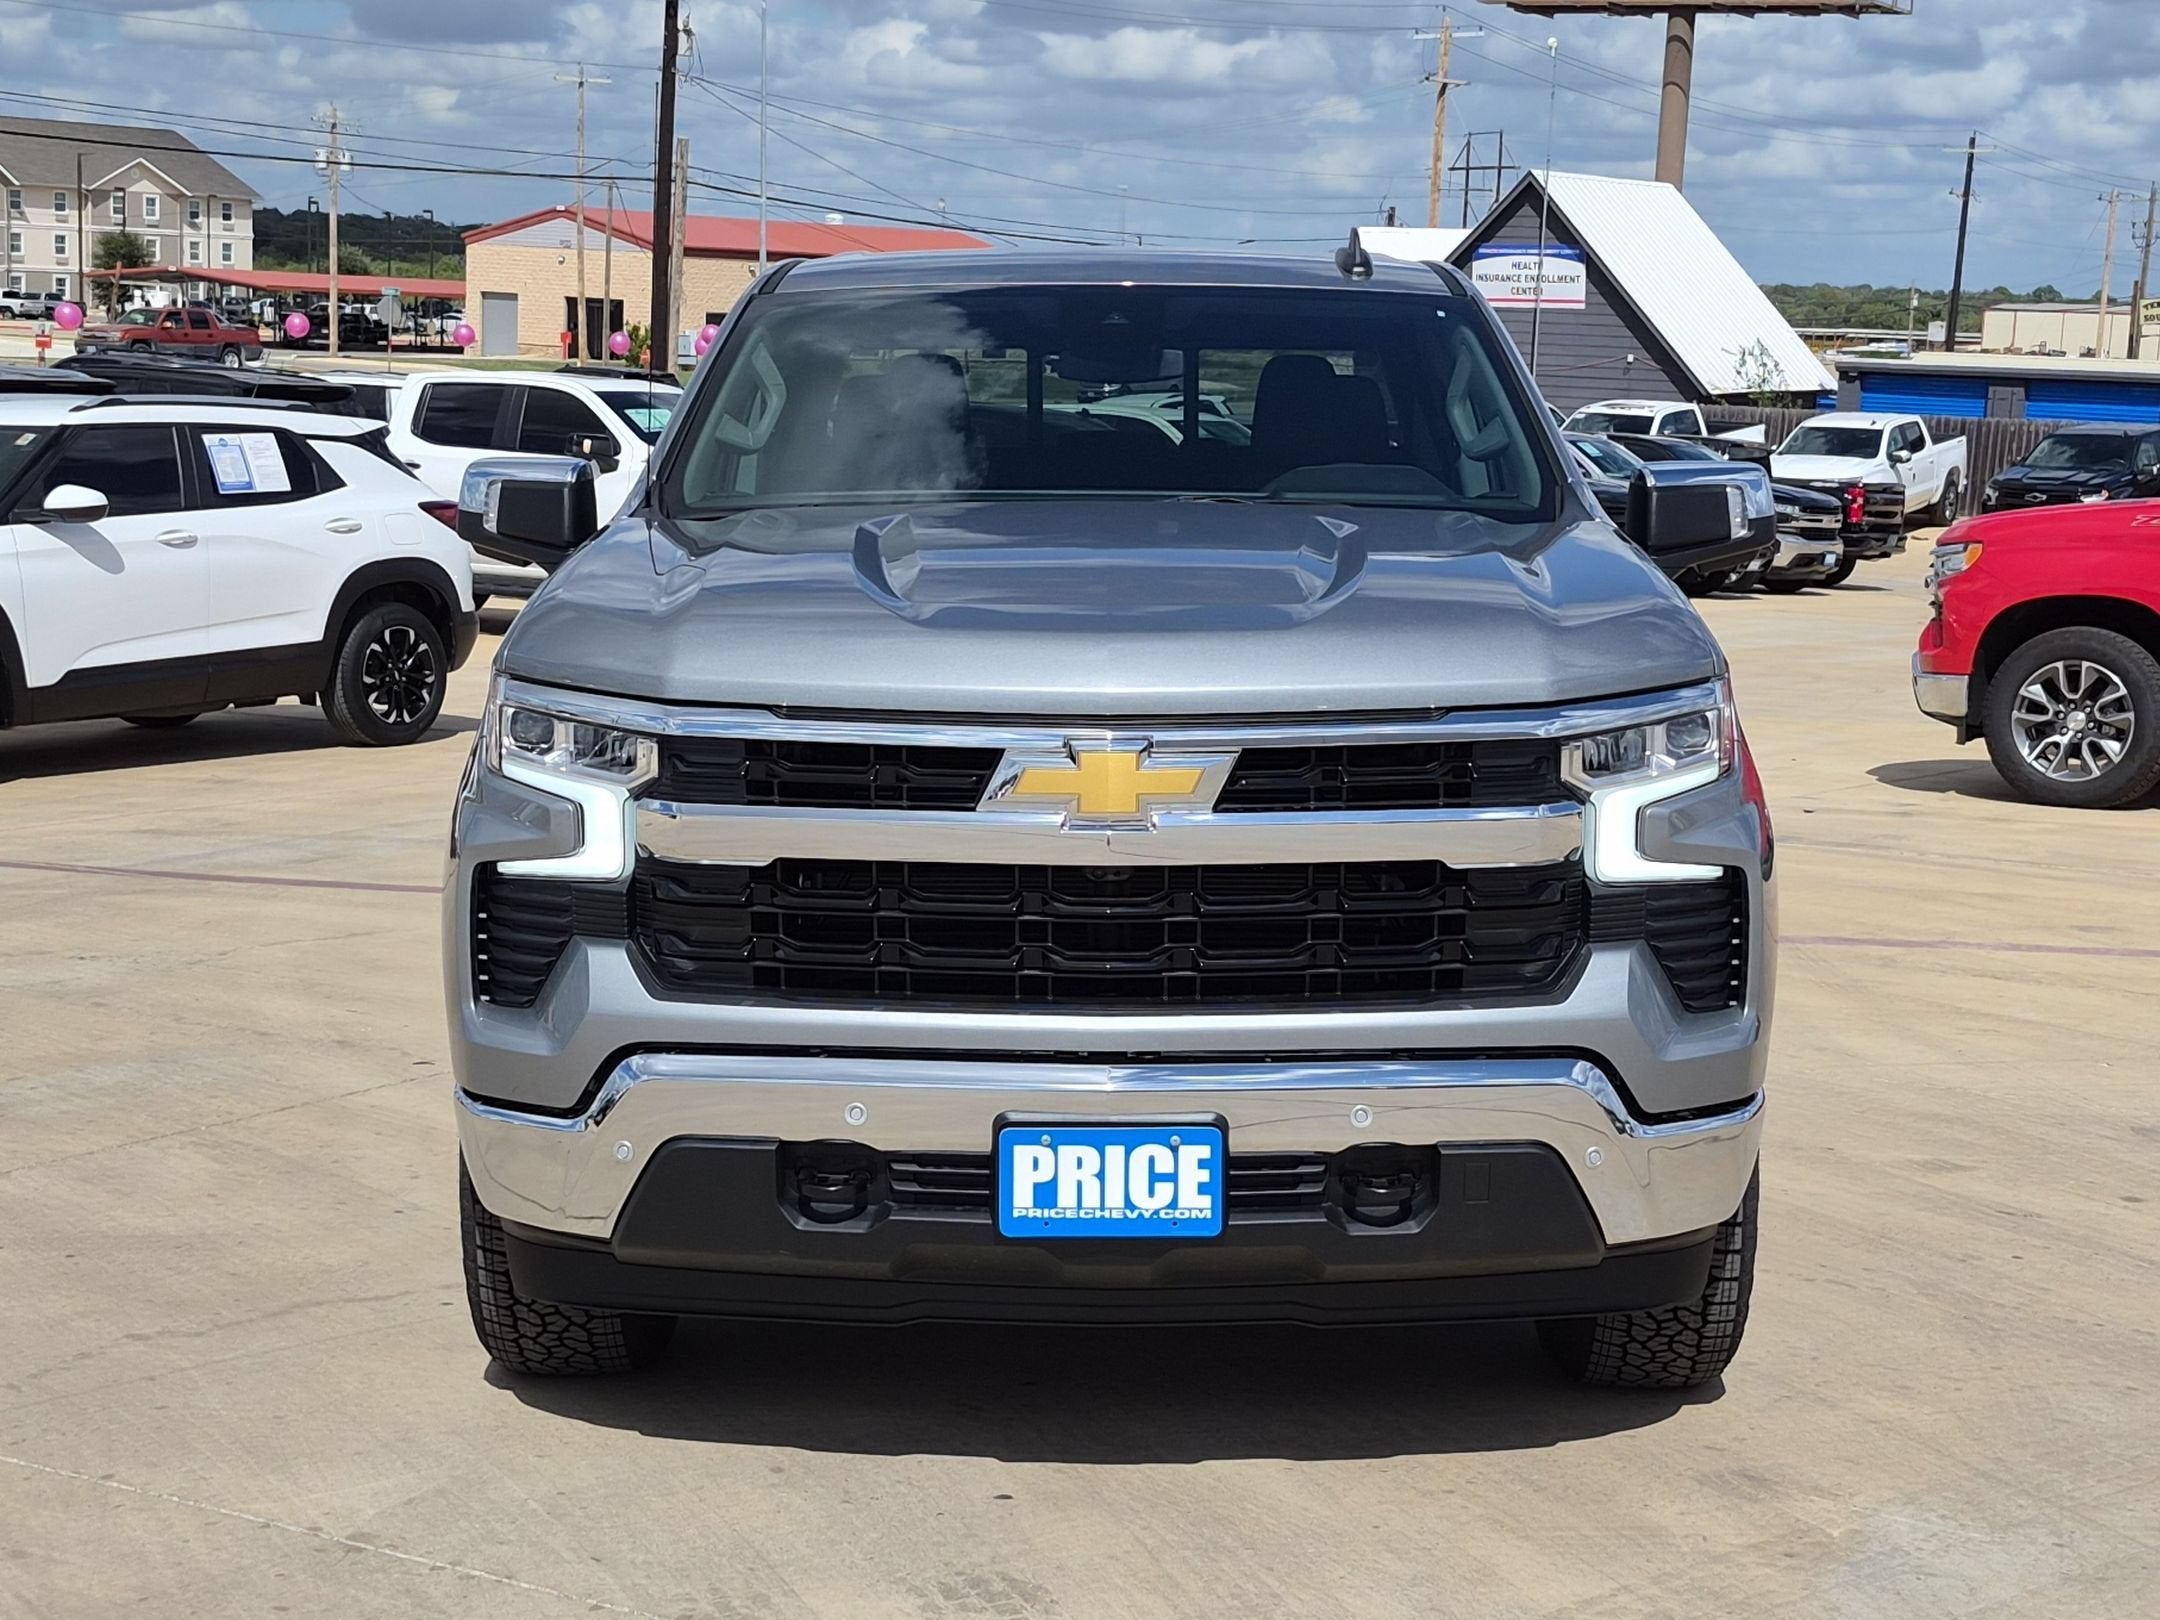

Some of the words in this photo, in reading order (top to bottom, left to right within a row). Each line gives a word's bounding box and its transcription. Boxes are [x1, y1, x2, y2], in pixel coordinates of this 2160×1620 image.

[1475, 273, 1522, 283] INSURANCE
[1012, 1143, 1212, 1210] PRICE
[1012, 1208, 1213, 1219] PRICECHEVY.COM
